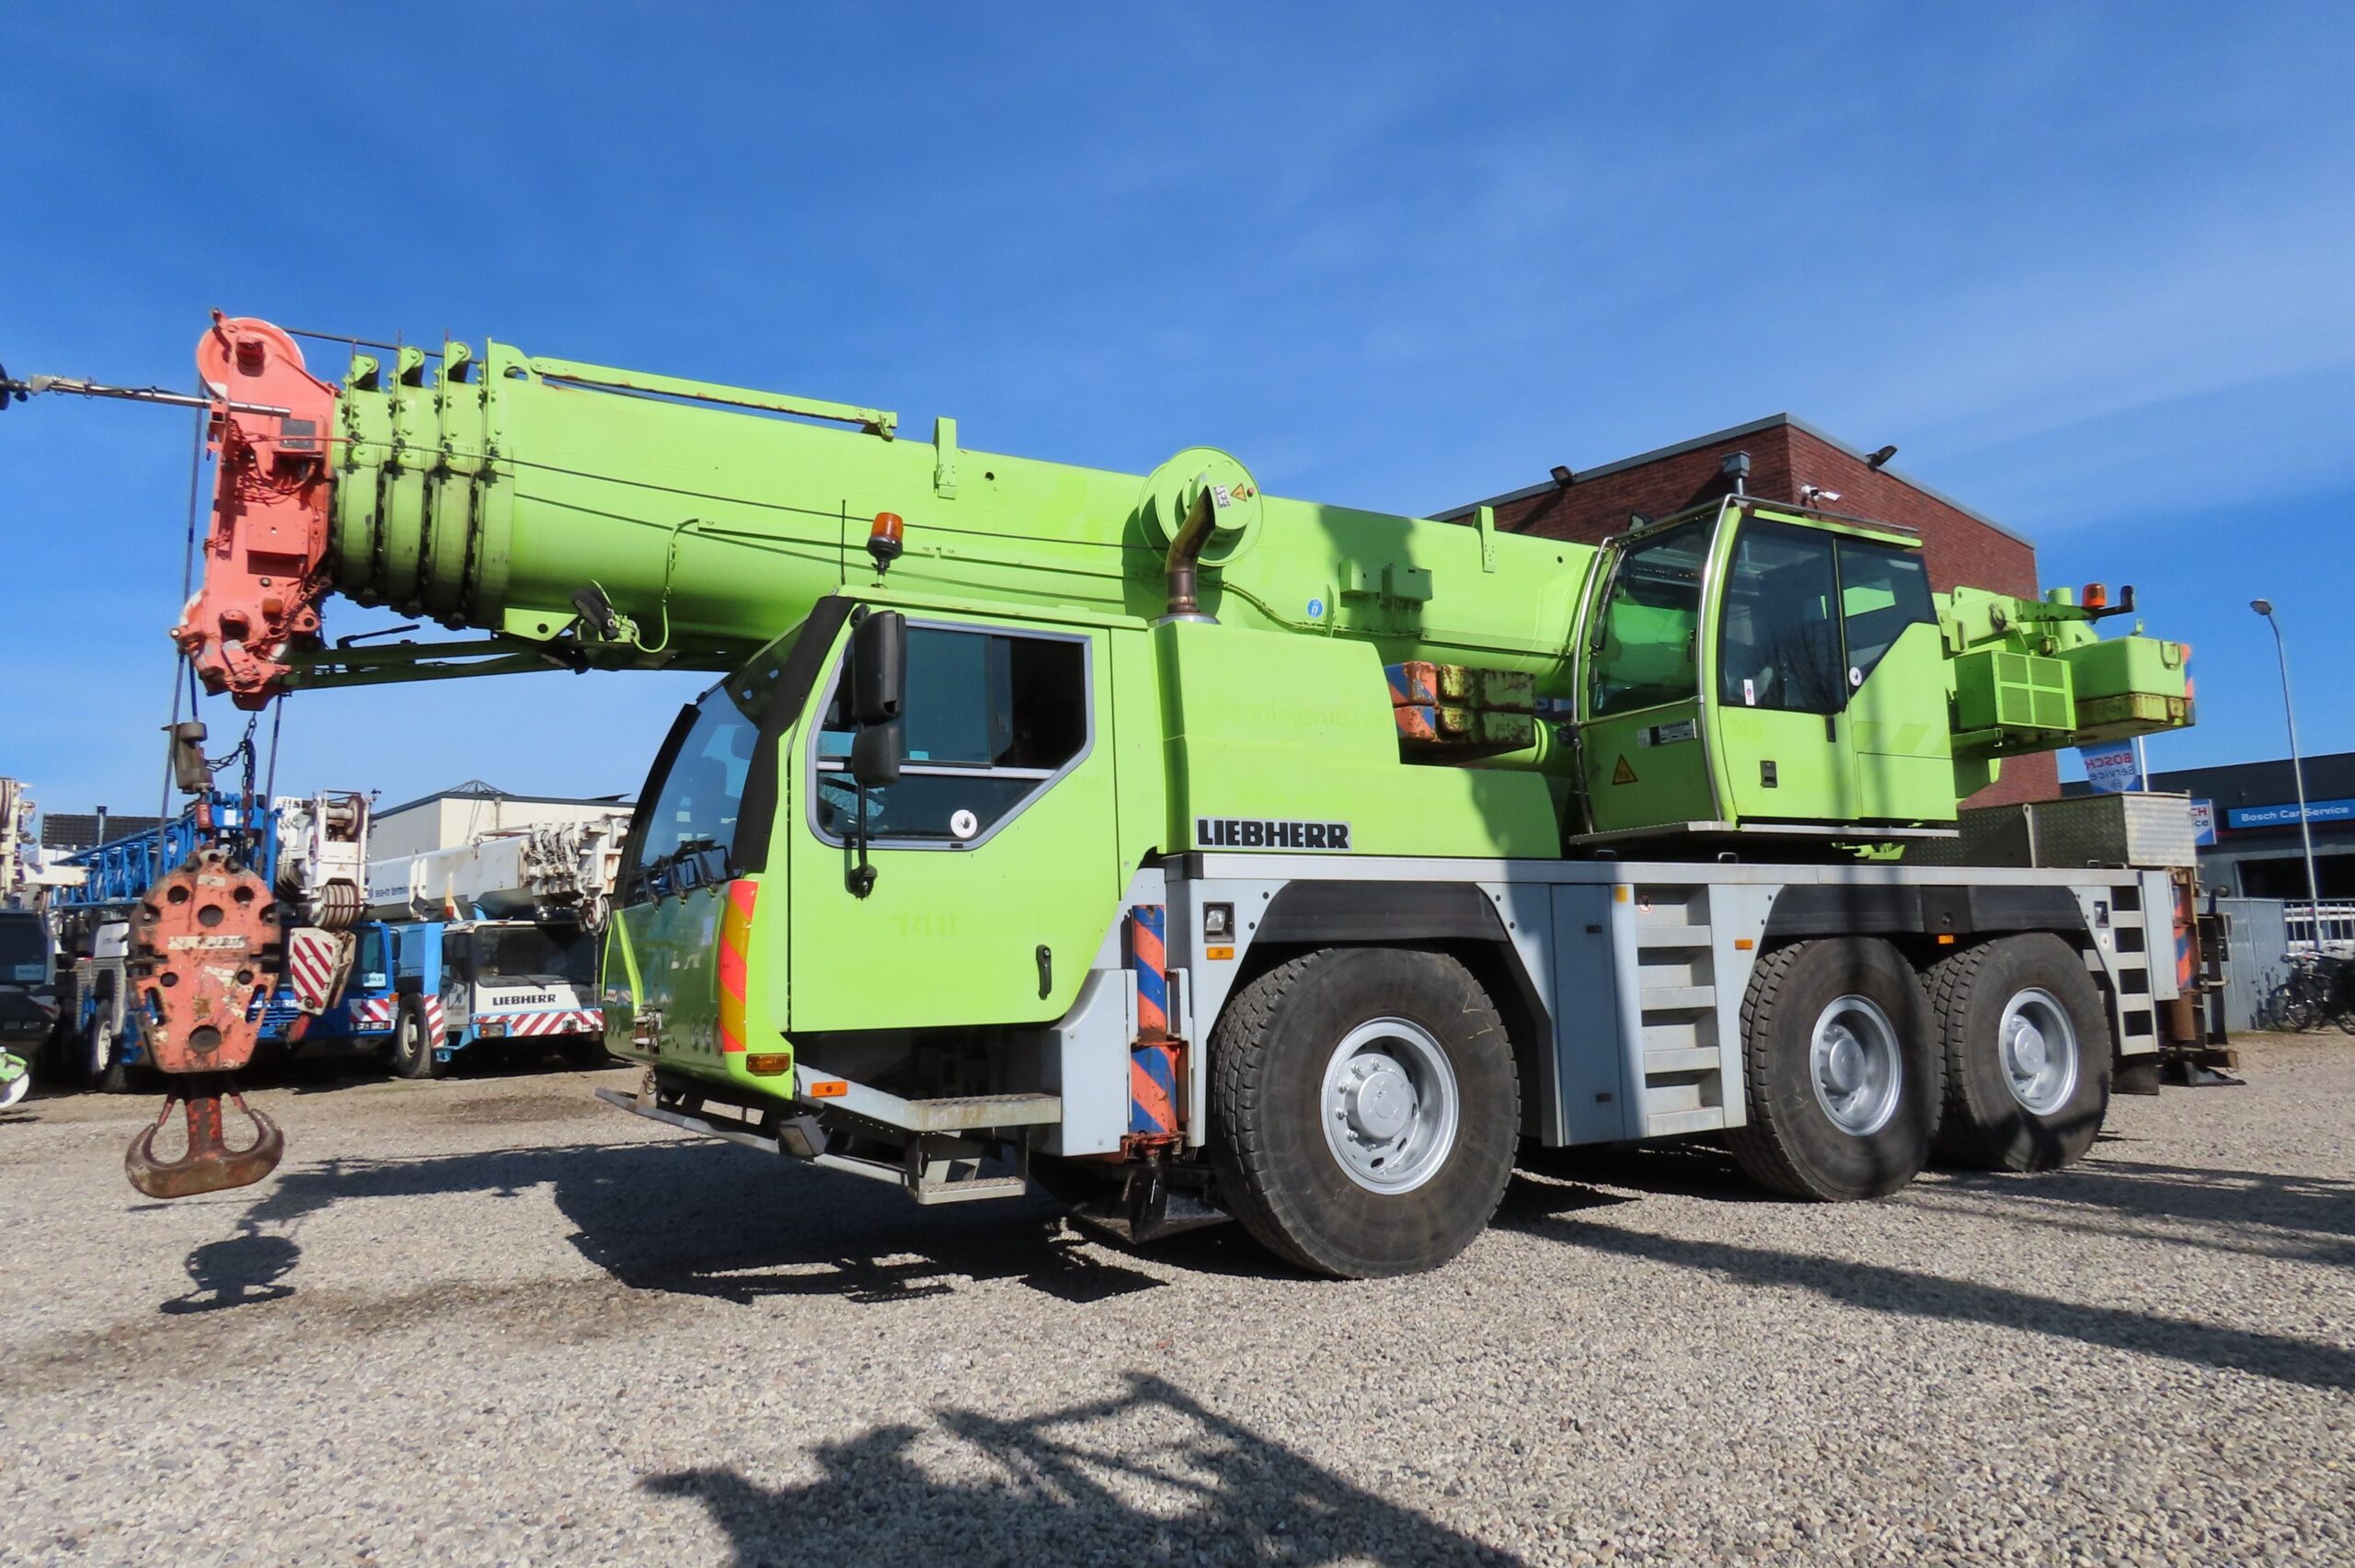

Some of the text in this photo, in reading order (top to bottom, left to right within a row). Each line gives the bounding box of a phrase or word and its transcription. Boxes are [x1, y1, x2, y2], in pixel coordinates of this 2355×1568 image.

[2241, 806, 2349, 822] Bosch Car Service
[1198, 819, 1349, 849] LIEBHERR
[492, 994, 557, 1006] LIEBHERR
